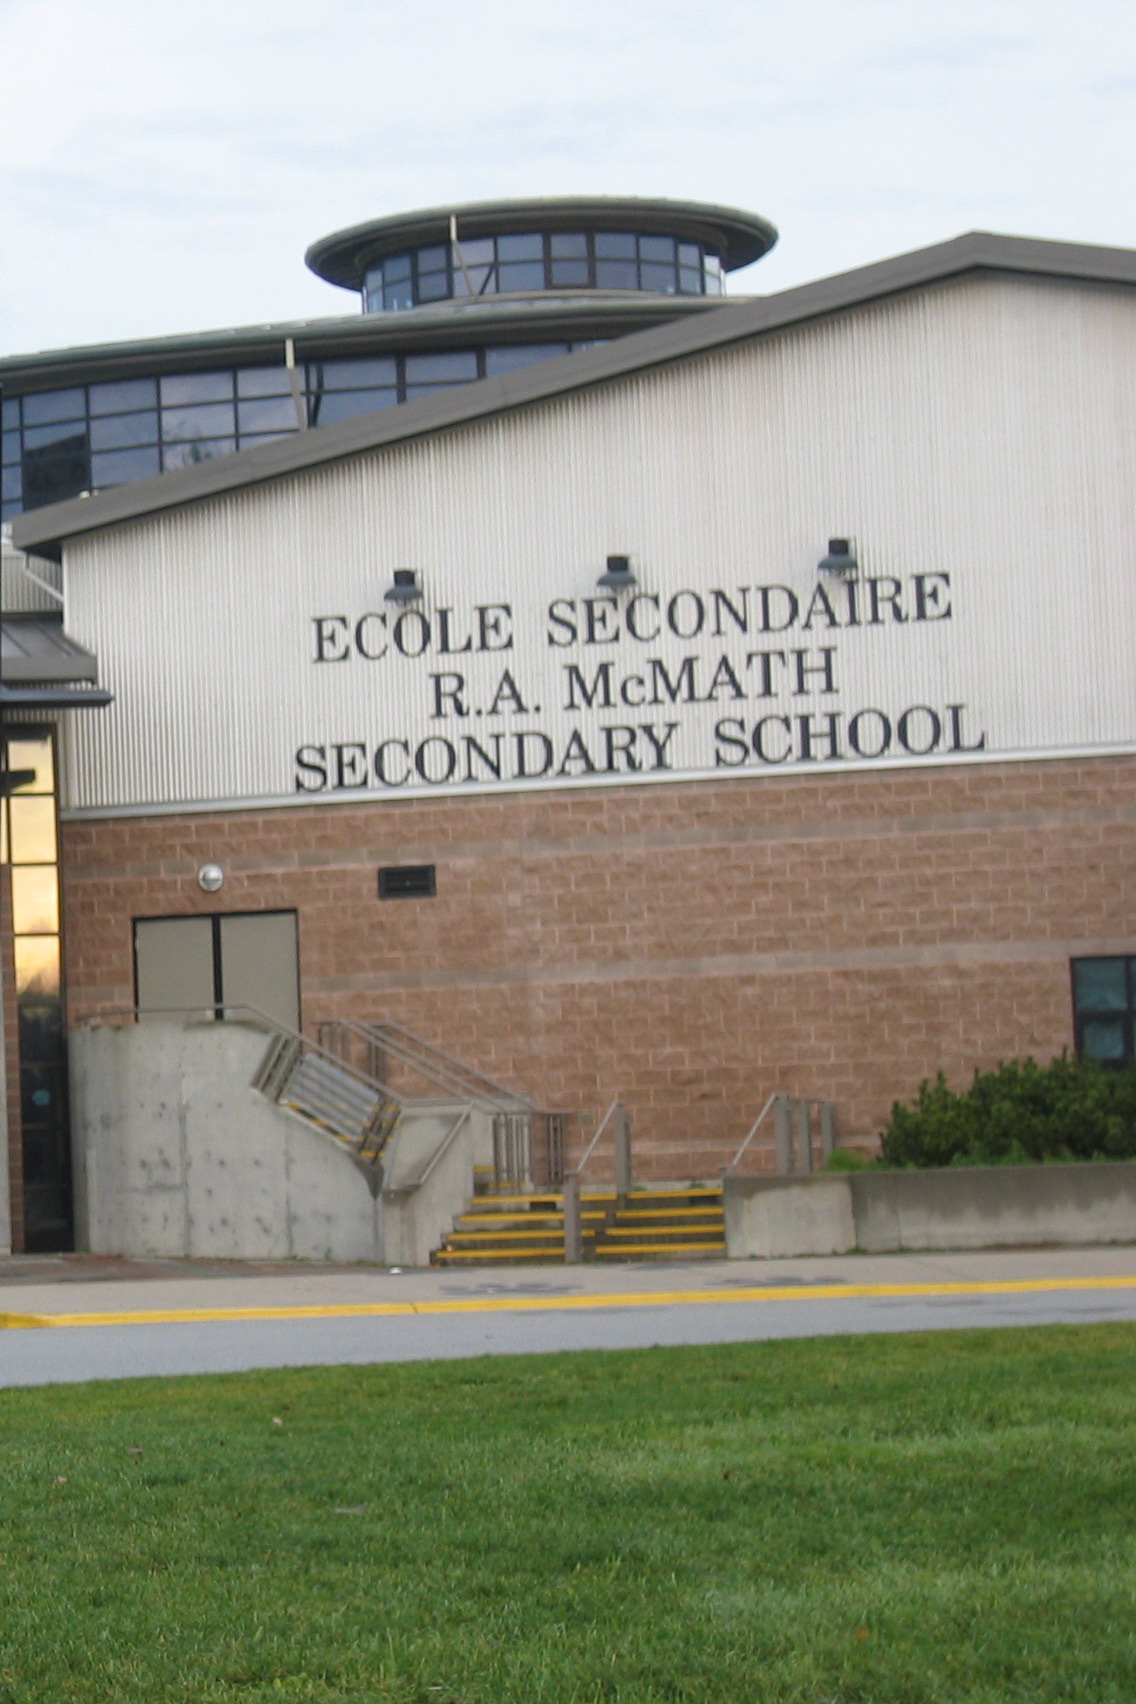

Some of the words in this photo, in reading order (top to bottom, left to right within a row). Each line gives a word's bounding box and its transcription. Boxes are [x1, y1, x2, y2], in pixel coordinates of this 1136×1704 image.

[312, 603, 514, 663] ECOLE
[547, 573, 952, 647] SECONDAIRE
[429, 670, 543, 719] R.A.
[563, 647, 839, 711] McMATH
[294, 722, 679, 793] SECONDARY
[714, 705, 986, 767] SCHOOL
